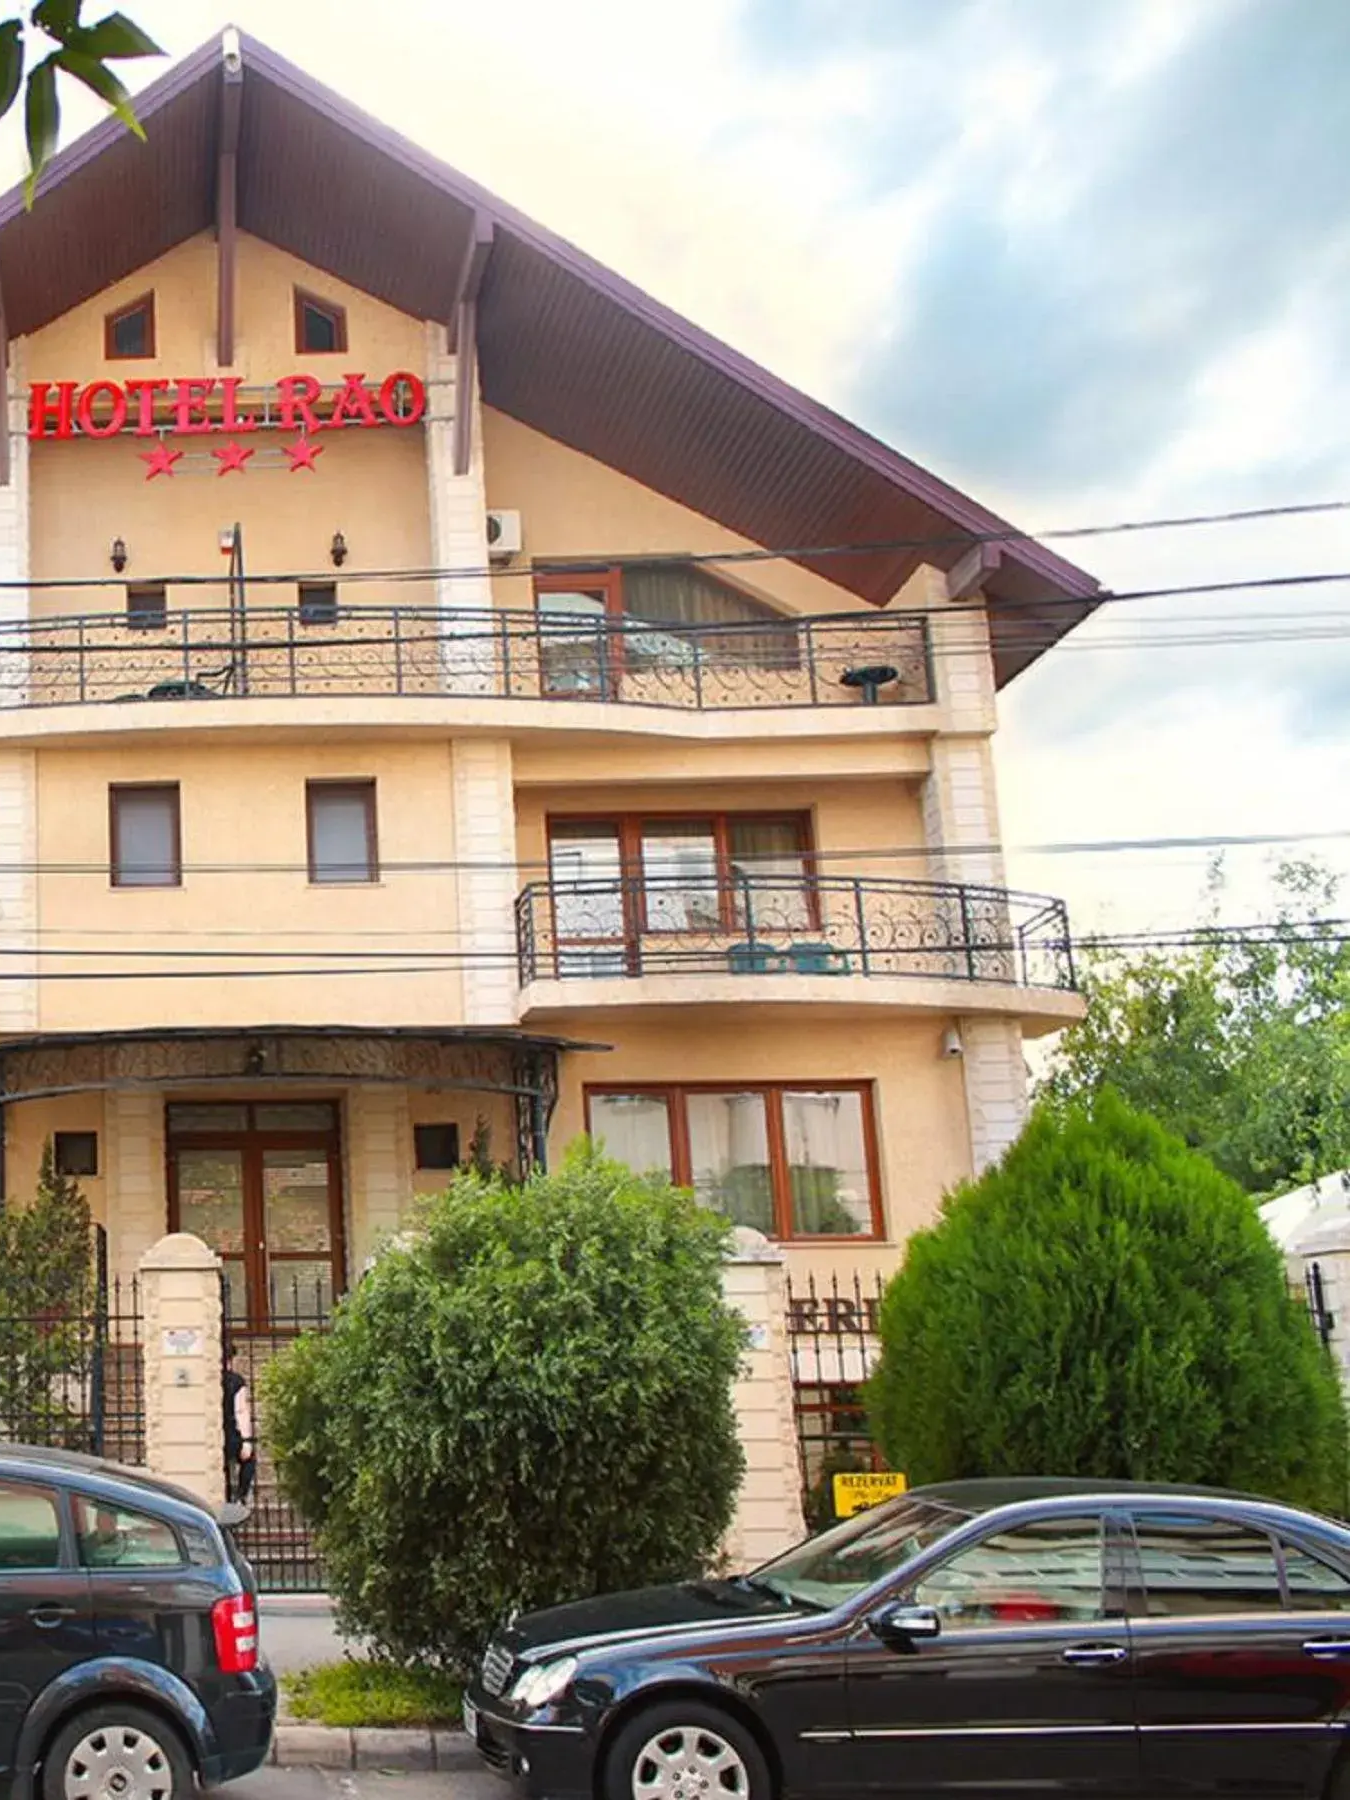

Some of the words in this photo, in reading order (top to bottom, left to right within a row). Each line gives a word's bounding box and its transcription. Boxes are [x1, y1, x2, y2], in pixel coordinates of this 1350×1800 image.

[28, 377, 257, 441] HOTEL
[276, 370, 427, 433] RAO
[841, 1476, 898, 1488] REZERVAT
